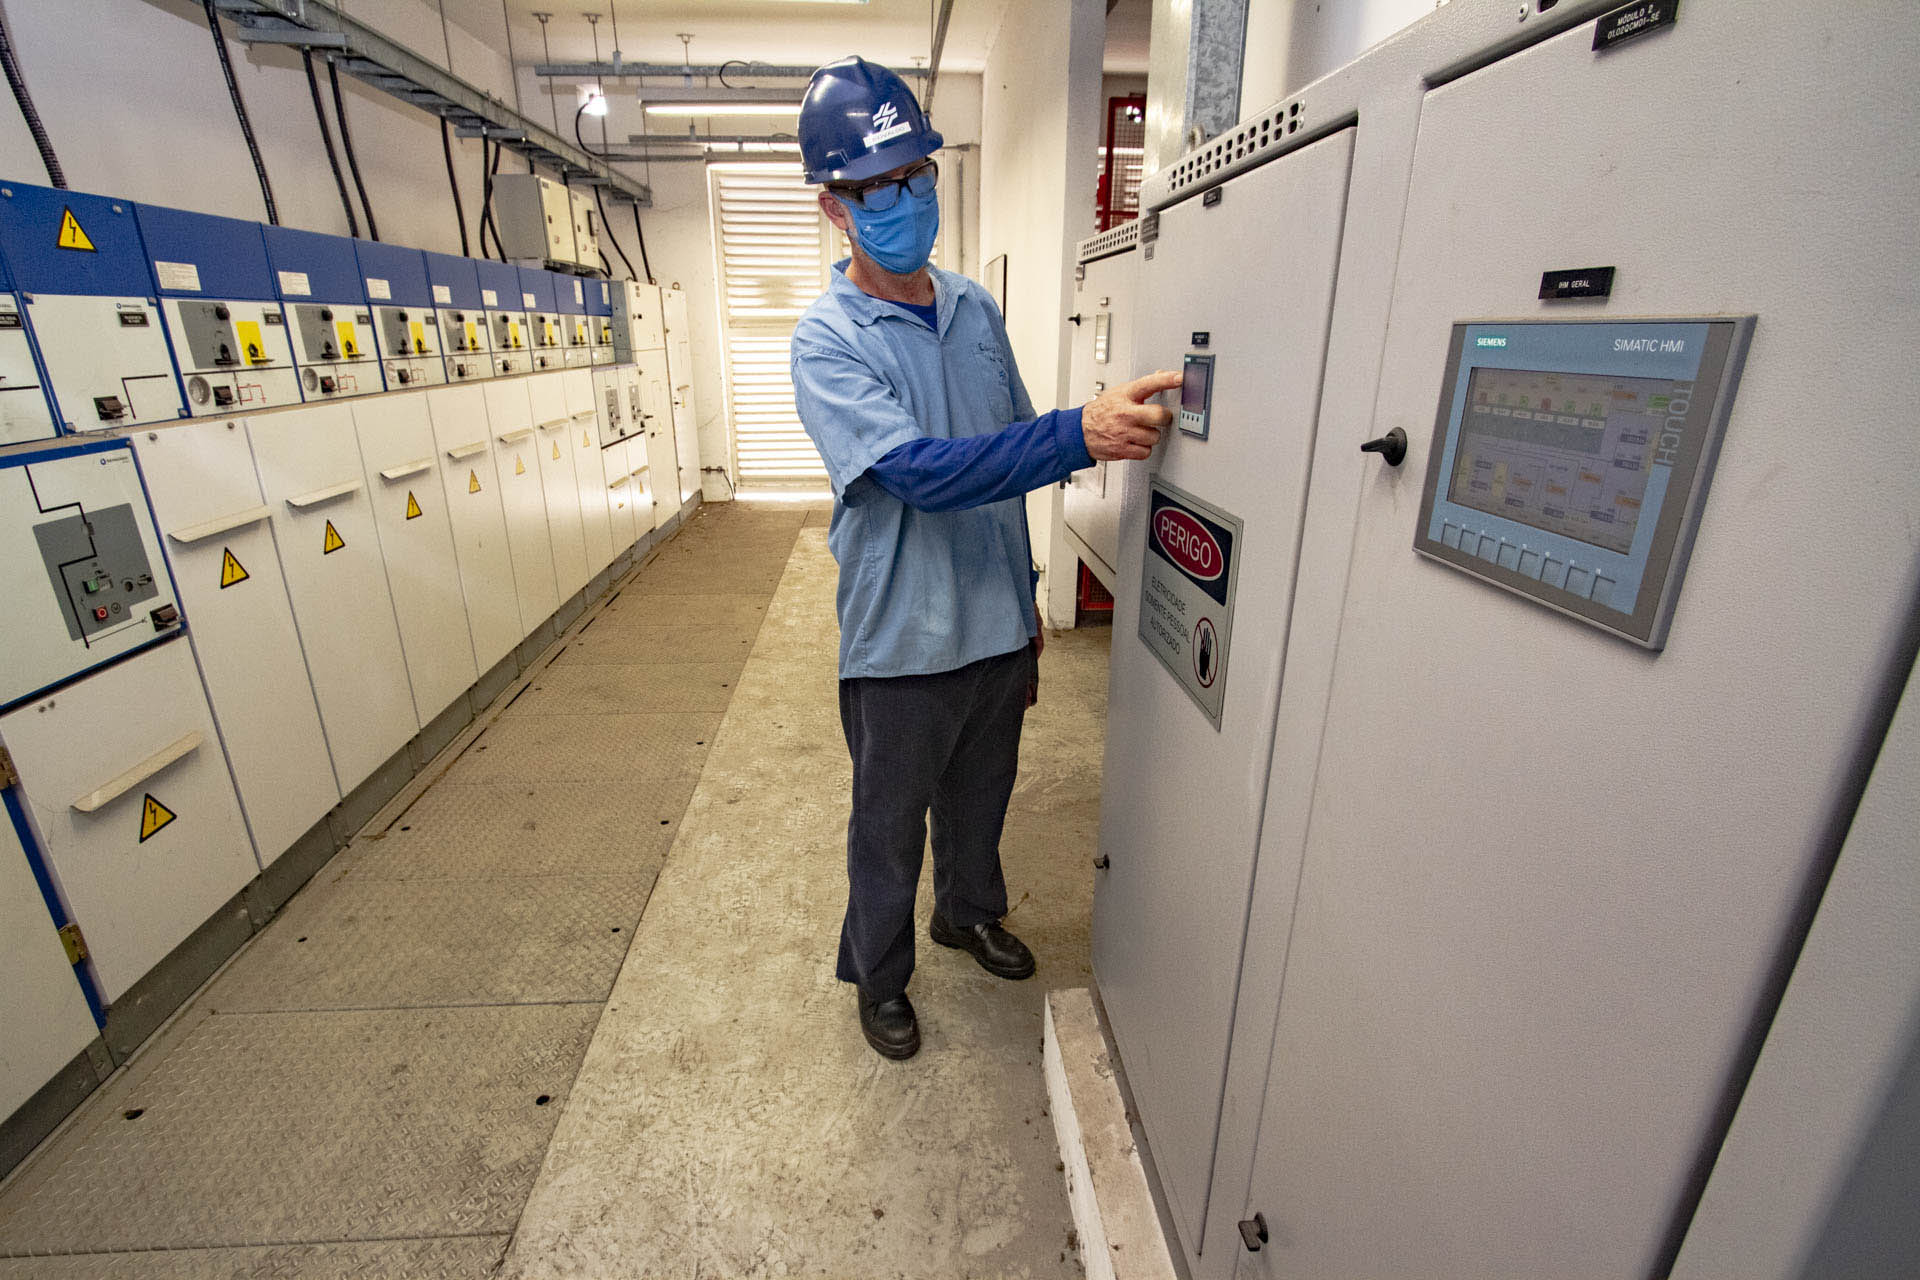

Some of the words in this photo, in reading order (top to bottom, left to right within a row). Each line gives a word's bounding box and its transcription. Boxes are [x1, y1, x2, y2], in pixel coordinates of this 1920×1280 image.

[1571, 279, 1591, 289] GERAL
[1476, 337, 1507, 347] SIEMENS
[1613, 338, 1659, 352] SIMATIC
[1660, 339, 1685, 353] HMI
[1655, 383, 1695, 466] TOUCH
[1160, 514, 1212, 569] PERIGO
[1151, 575, 1187, 616] ELETRICIDADE
[1144, 590, 1167, 620] SOMENTE
[1167, 611, 1191, 644] PESSOAL
[1150, 615, 1180, 655] AUTORIZADO
